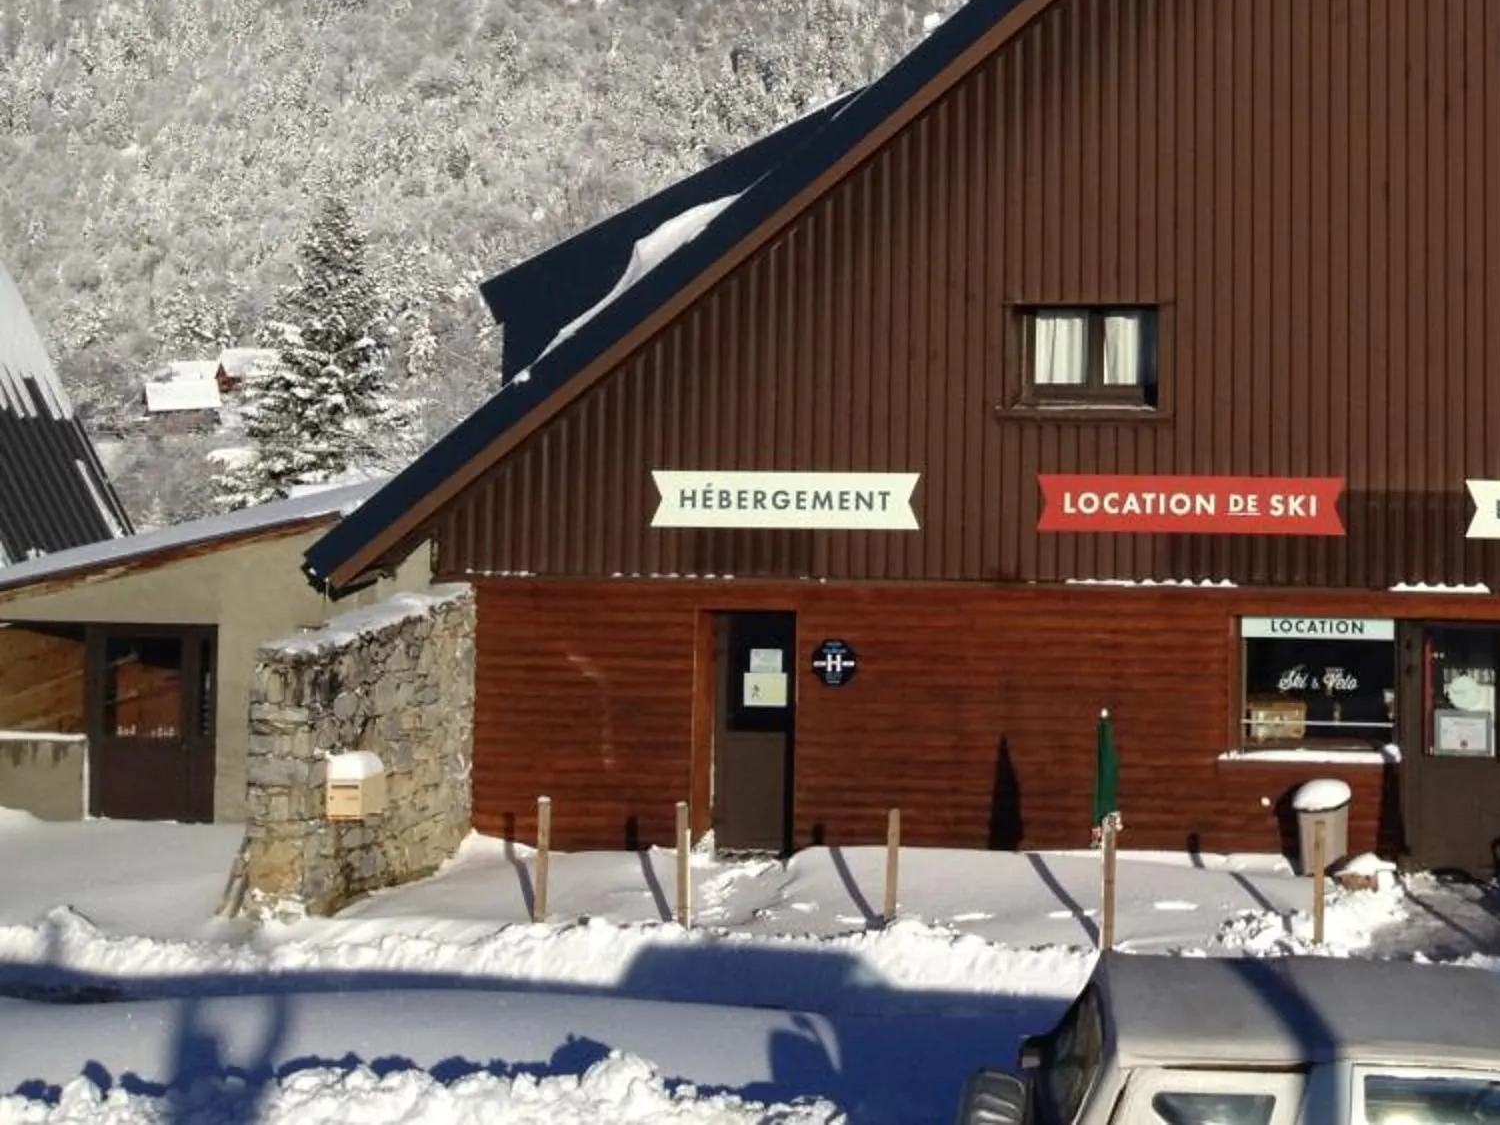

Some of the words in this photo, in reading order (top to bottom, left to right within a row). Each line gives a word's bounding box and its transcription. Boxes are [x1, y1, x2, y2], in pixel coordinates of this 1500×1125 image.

[678, 481, 892, 514] HÉBERGEMENT
[1062, 490, 1217, 517] LOCATION
[1227, 494, 1261, 517] DE
[1269, 492, 1318, 518] SKI
[1270, 618, 1366, 635] LOCATION
